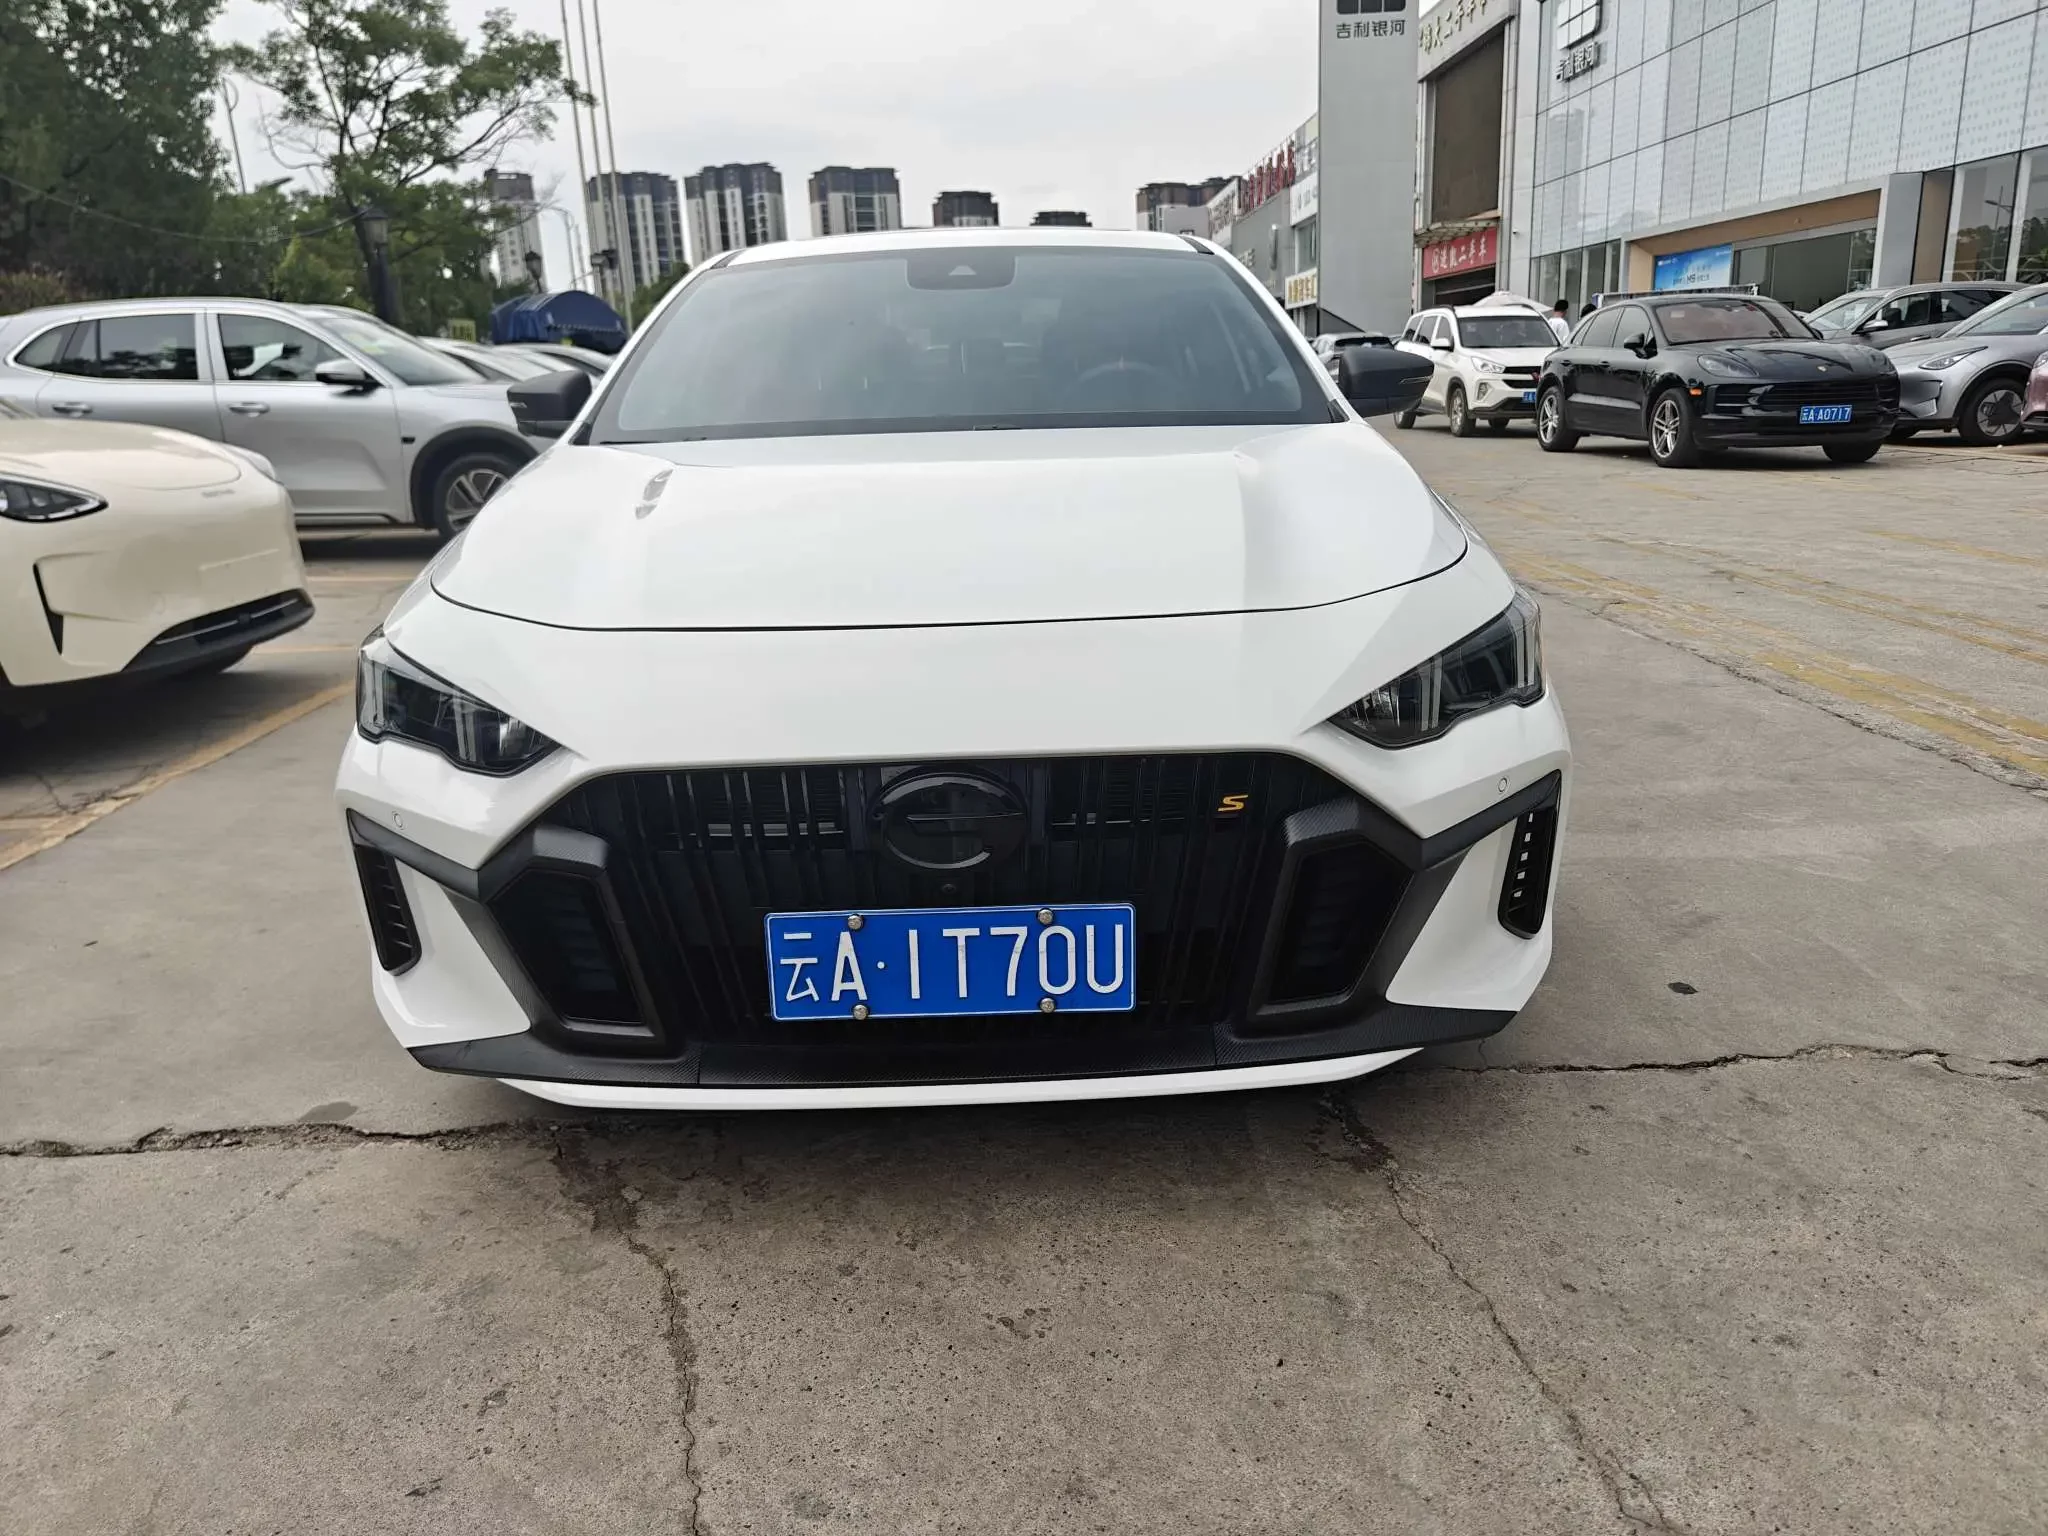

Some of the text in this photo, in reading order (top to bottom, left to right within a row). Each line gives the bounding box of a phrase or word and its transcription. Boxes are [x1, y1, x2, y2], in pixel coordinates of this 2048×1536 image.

[1336, 20, 1405, 39] 吉利银河
[1556, 42, 1599, 81] 吉利银河
[1217, 794, 1249, 812] S
